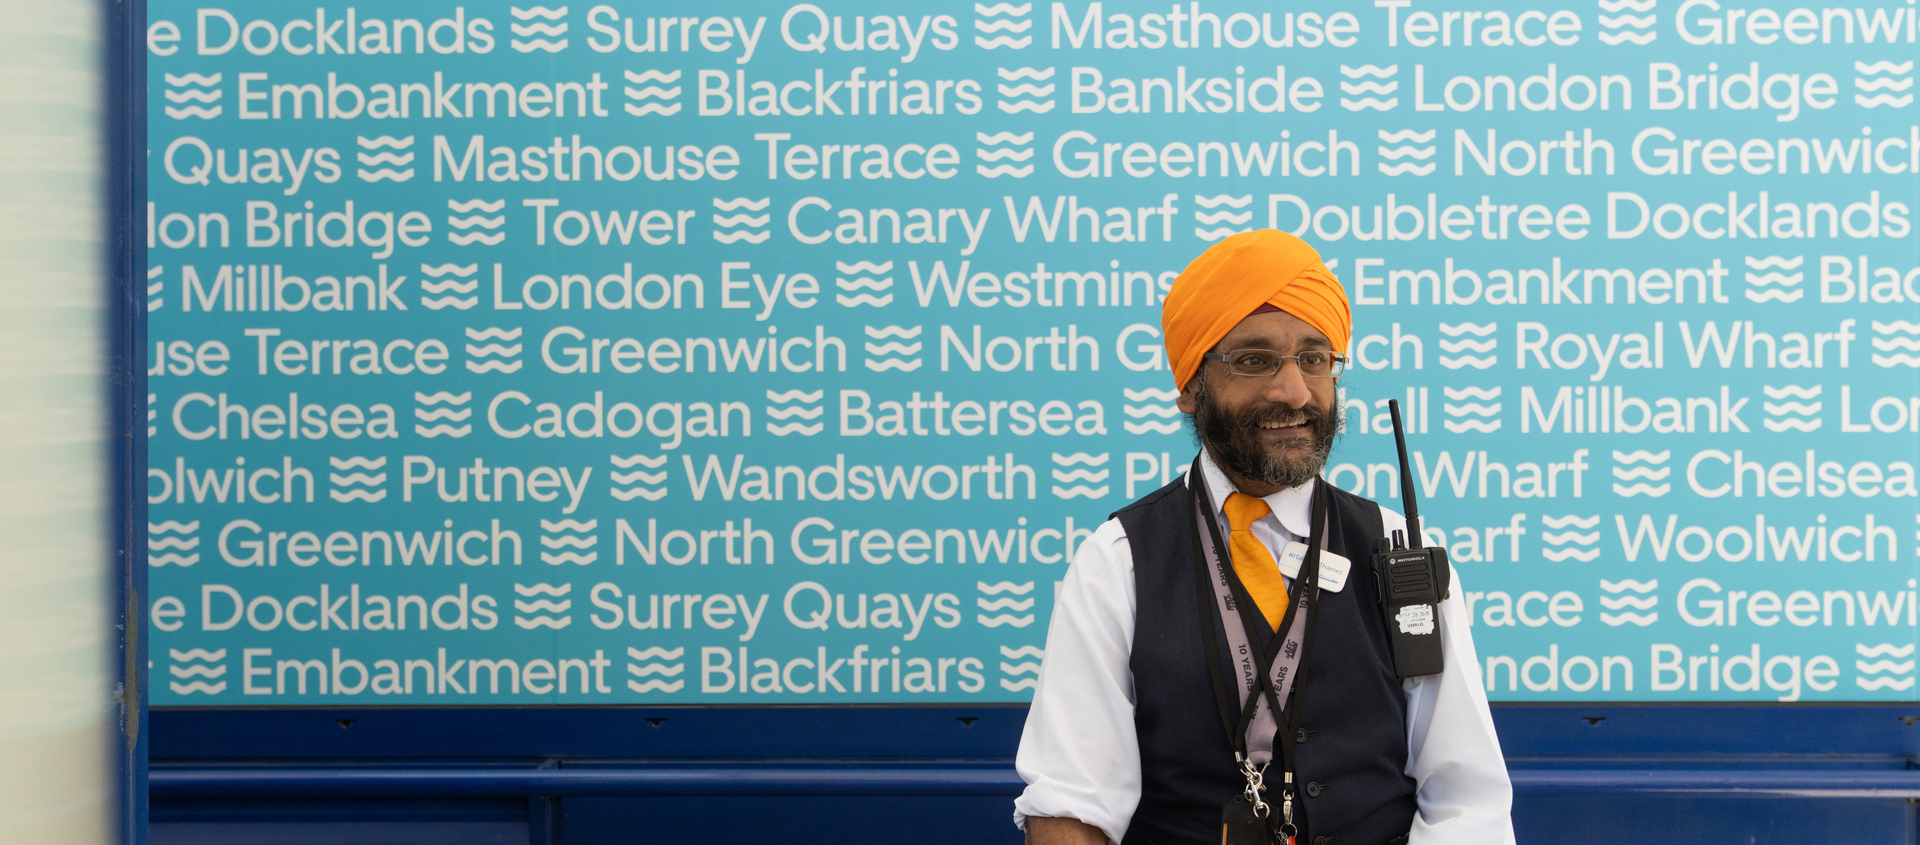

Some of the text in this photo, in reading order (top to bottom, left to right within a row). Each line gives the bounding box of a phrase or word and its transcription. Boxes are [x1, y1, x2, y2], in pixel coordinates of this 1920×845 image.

[197, 7, 495, 55] Docklands
[587, 5, 767, 64] Surrey
[781, 3, 959, 63] Quays
[1051, 1, 1360, 49] Masthouse
[1374, 0, 1582, 47] Terrace
[1675, 0, 1920, 46] Greenwi
[239, 61, 1839, 122] Embankment Blackfriars Bankside London Bridge
[164, 137, 341, 195] Quays
[434, 134, 740, 182] Masthouse
[754, 133, 960, 180] Terrace
[1053, 129, 1360, 178] Greenwich
[1454, 128, 1615, 176] North
[247, 201, 431, 259] Bridge
[523, 199, 695, 246] Tower
[788, 197, 991, 256] Canary
[1004, 193, 1178, 243] Wharf
[1269, 193, 1591, 243] Doubletree
[1607, 190, 1911, 240] Docklands
[183, 264, 407, 311] Millbank
[494, 263, 703, 310] London
[722, 262, 820, 321] Eye
[1355, 257, 1729, 305] Embankment
[245, 329, 449, 375] Terrace
[542, 325, 846, 373] Greenwich
[941, 324, 1099, 372] North
[1516, 321, 1663, 382] Royal
[1678, 318, 1856, 369] Wharf
[173, 393, 398, 440] Chelsea
[488, 391, 750, 450] Cadogan
[840, 389, 1107, 436] Battersea
[1521, 385, 1750, 434] Millbank
[404, 456, 592, 514] Putney
[682, 453, 1036, 501] Wandsworth
[1126, 452, 1192, 499] Pl
[1413, 448, 1589, 498] Wharf
[1686, 449, 1918, 498] Chelsea
[219, 519, 521, 566] Greenwich
[616, 518, 773, 565] North
[1615, 514, 1897, 562] Woolwich
[203, 584, 498, 630] Docklands
[591, 583, 769, 641] Surrey
[784, 581, 961, 640] Quays
[1677, 578, 1920, 627] Greenwi
[244, 643, 1840, 702] Embankment Blackfriars ndon Bridge
[1238, 644, 1247, 655] 10
